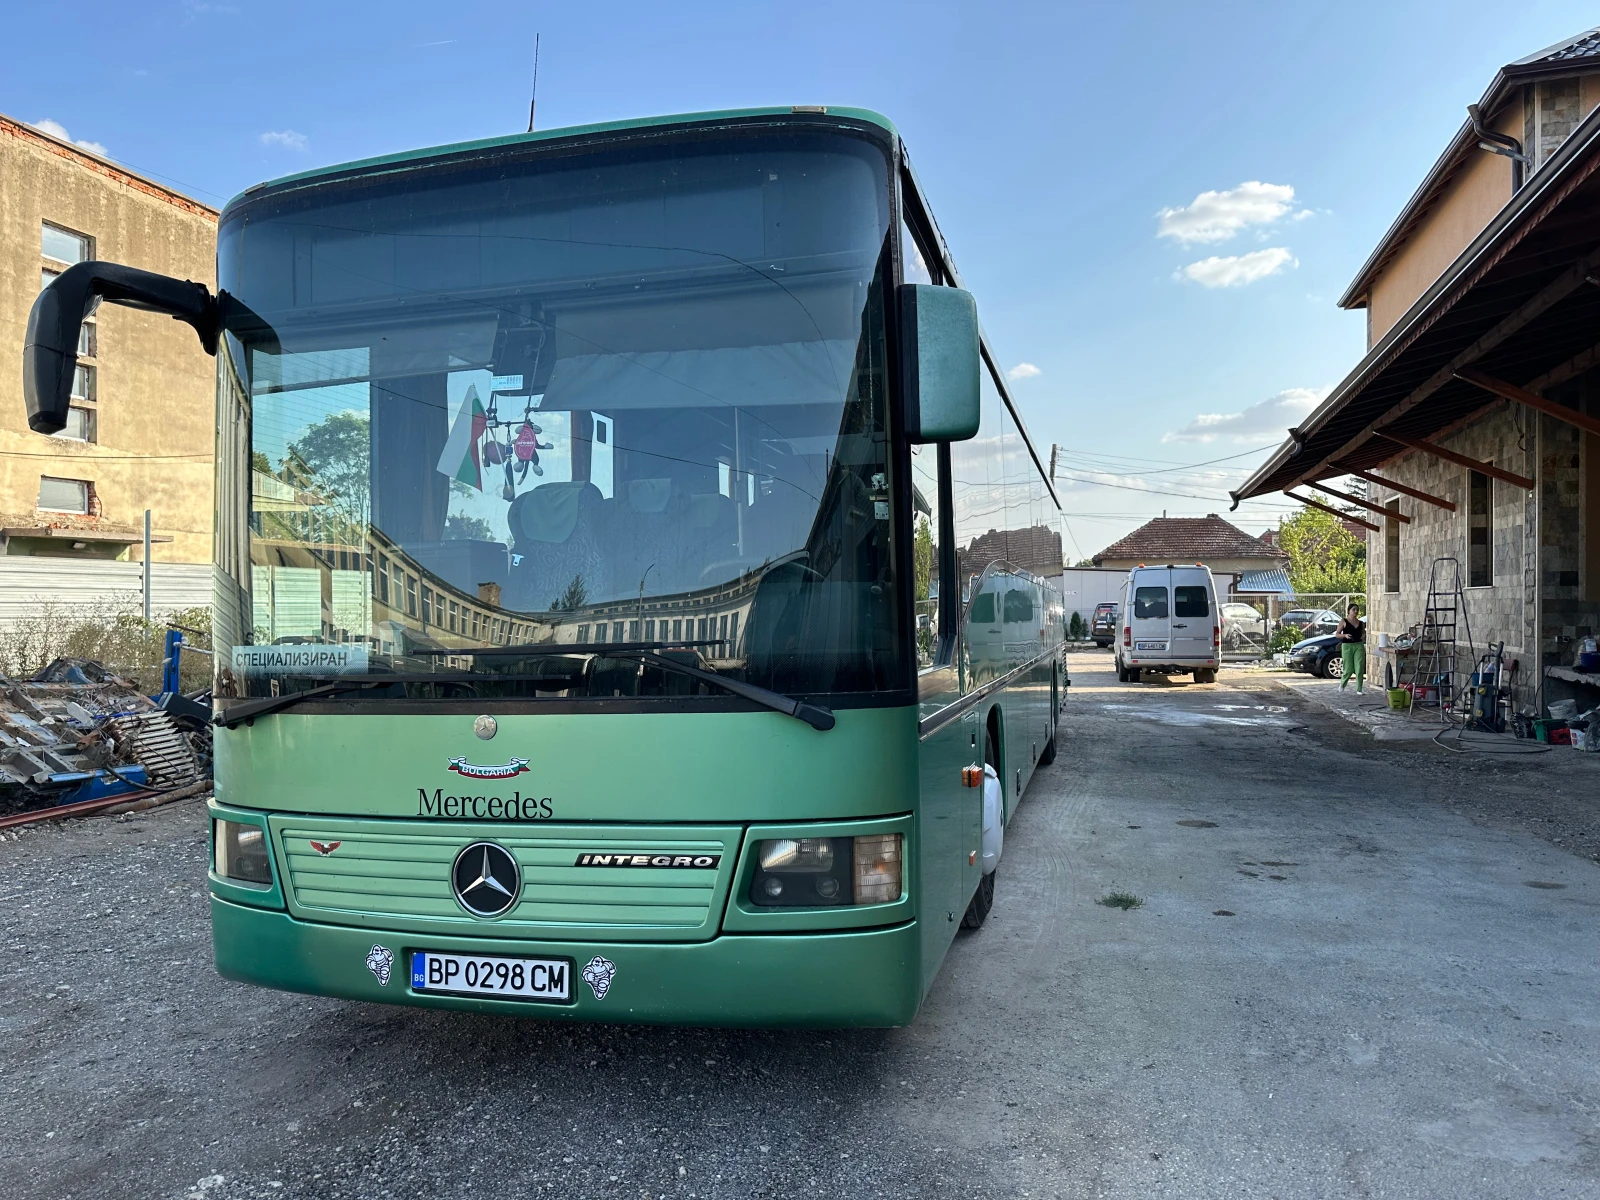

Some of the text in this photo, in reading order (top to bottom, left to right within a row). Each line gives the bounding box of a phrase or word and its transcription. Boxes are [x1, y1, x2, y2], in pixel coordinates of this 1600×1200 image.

[235, 652, 348, 668] СПЕЦИАЛИЗИРАН
[461, 766, 515, 776] BULGARIA
[417, 788, 553, 819] Mercedes
[581, 855, 713, 867] INTEGRO
[414, 973, 424, 982] BG
[429, 957, 565, 993] BP 0298 CM
